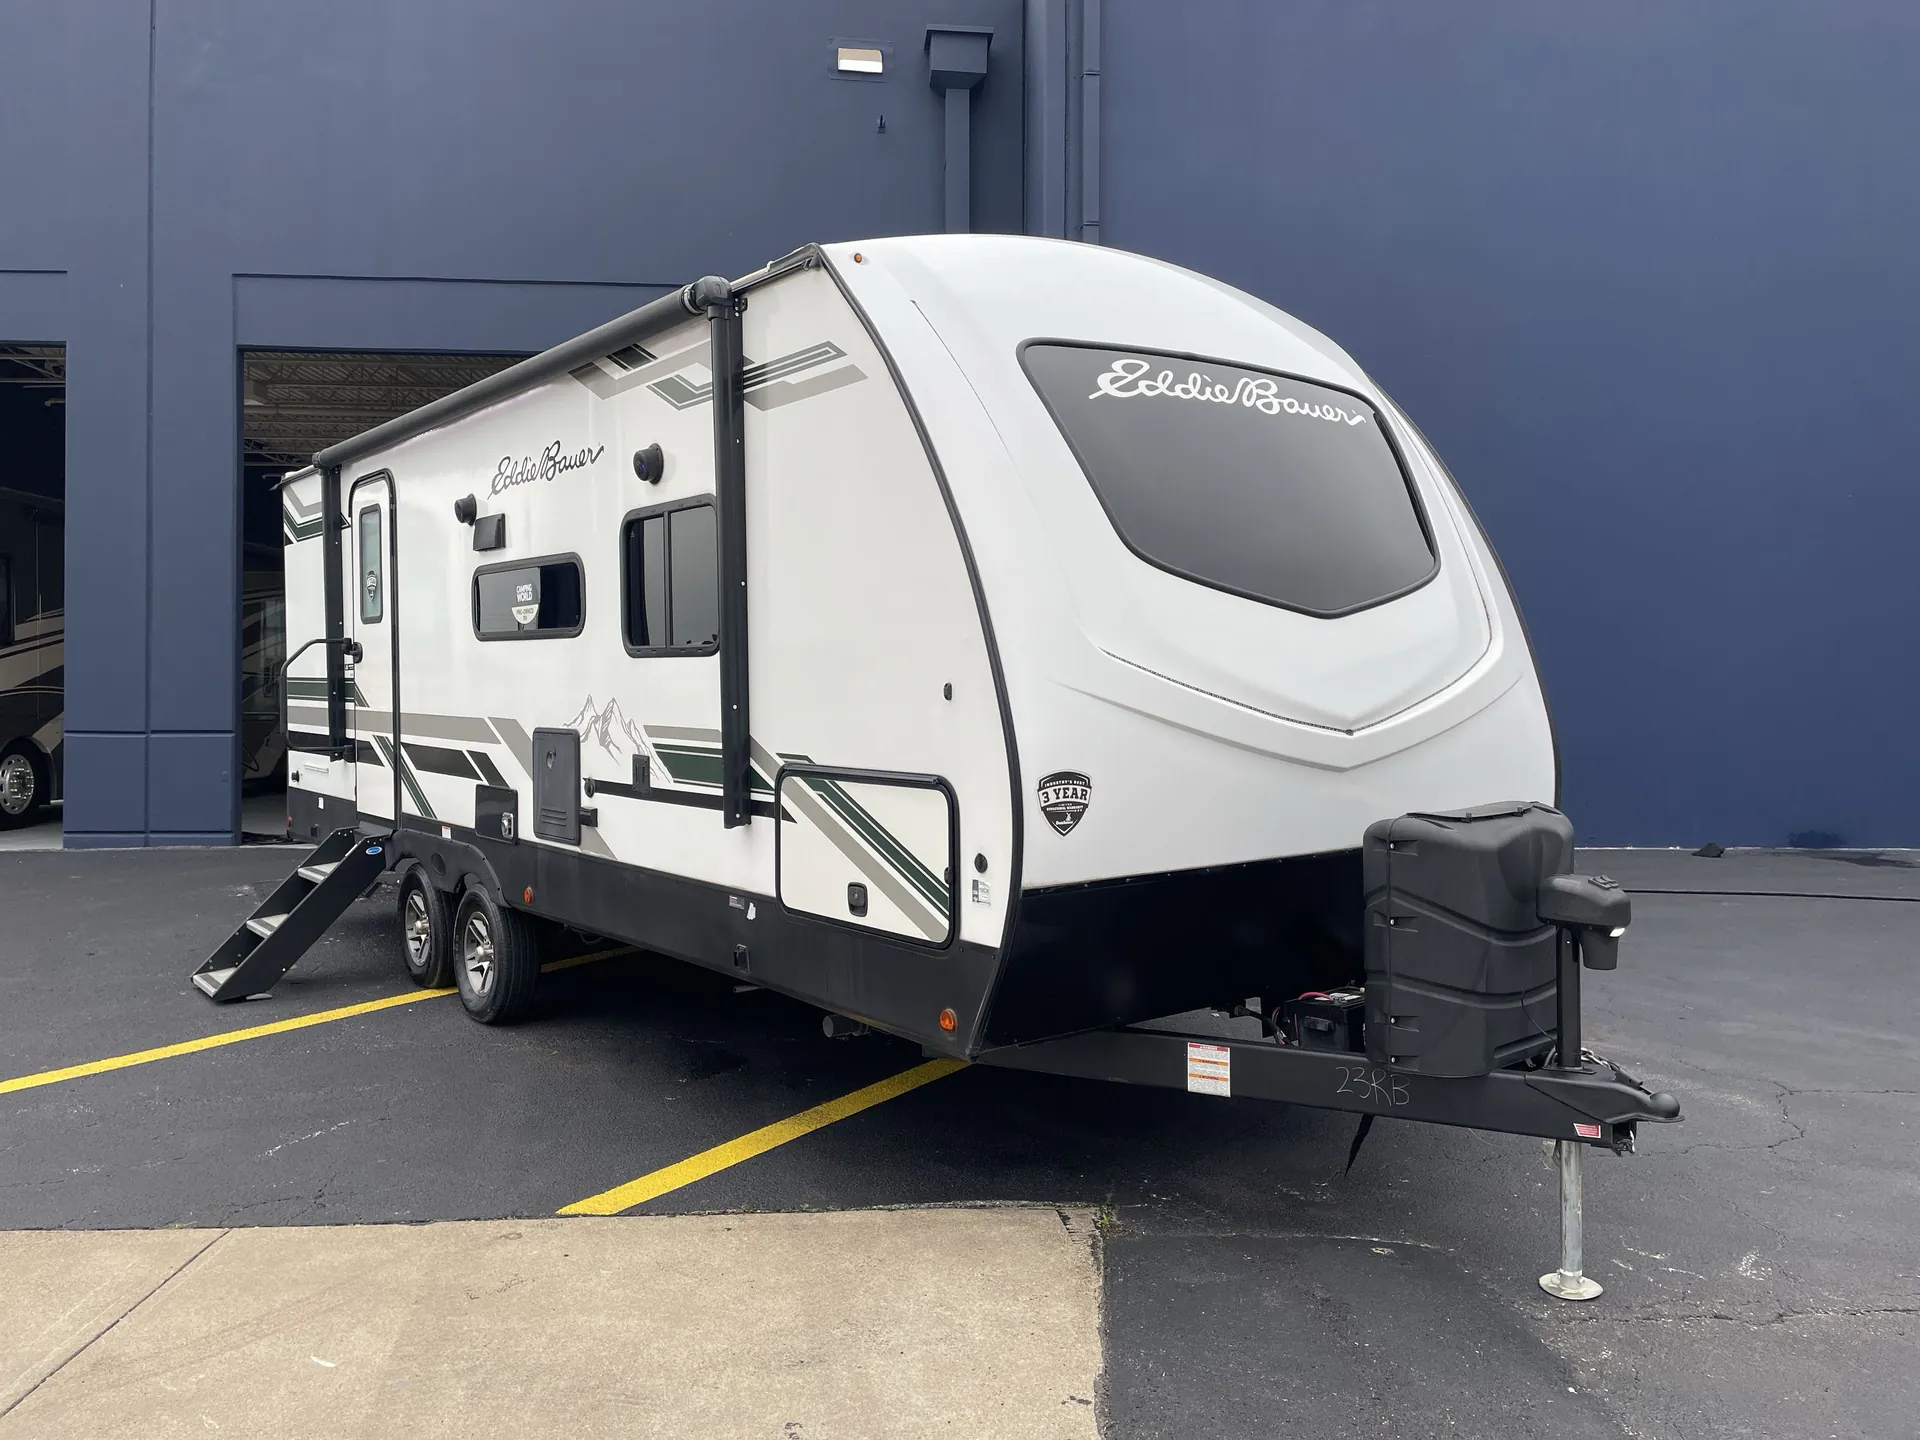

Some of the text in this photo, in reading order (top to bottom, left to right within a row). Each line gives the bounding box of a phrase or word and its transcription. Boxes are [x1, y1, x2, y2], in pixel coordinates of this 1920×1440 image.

[1089, 358, 1367, 426] Eddie Bauer
[487, 440, 604, 500] Eddie Bauer
[516, 591, 533, 602] WORLD
[1042, 787, 1088, 803] 3 YEAR
[1335, 1066, 1411, 1107] 23RB
